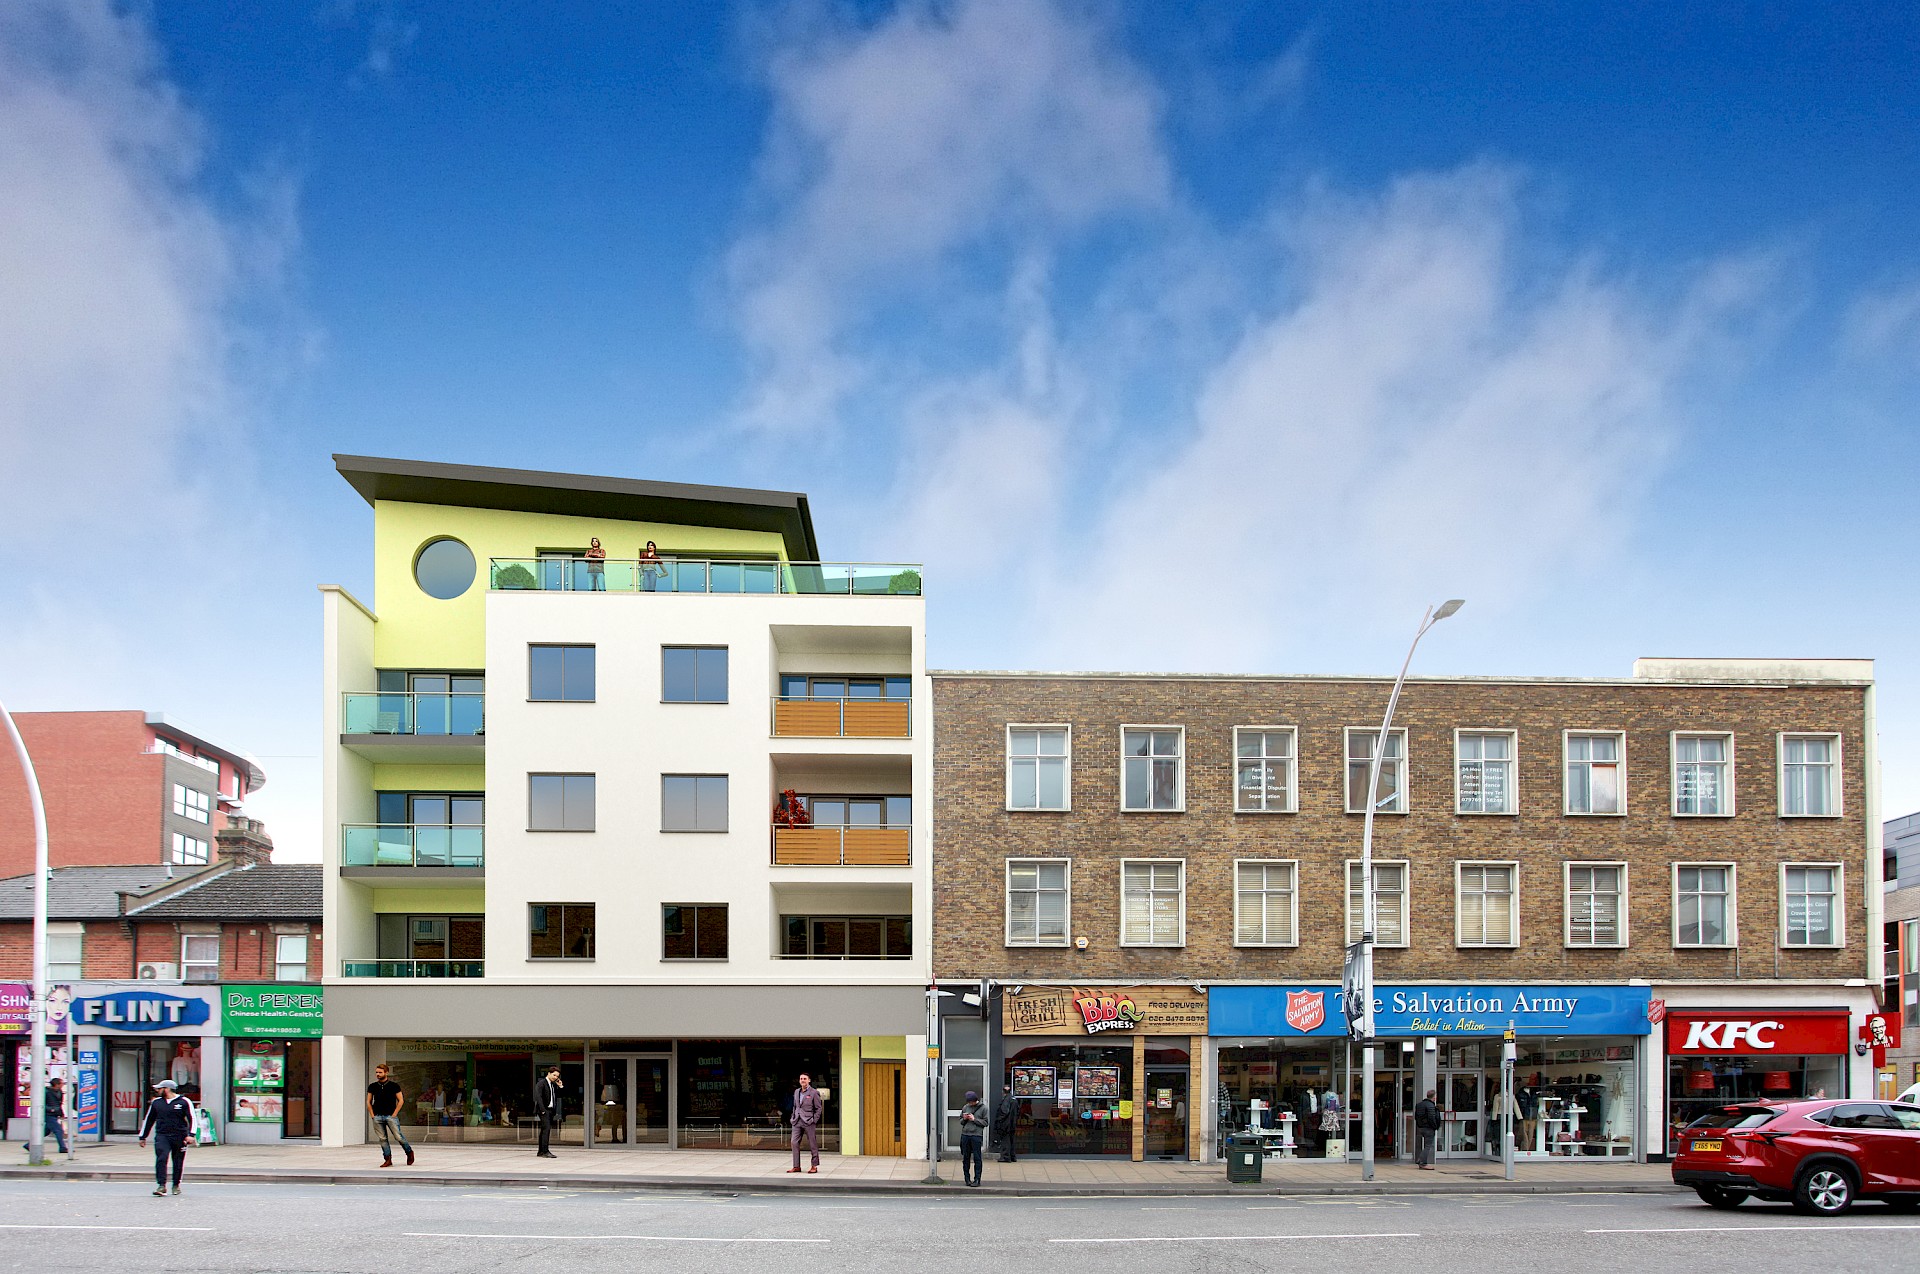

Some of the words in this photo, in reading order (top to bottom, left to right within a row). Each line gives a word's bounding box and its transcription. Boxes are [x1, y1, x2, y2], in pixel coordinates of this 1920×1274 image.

[228, 993, 255, 1008] Dr.
[1017, 997, 1057, 1011] FRESH
[1293, 995, 1309, 1008] THE
[1335, 992, 1384, 1014] Te
[1392, 991, 1504, 1014] Salvation
[1511, 991, 1579, 1018] Army
[83, 1000, 186, 1022] FLINT
[229, 1010, 260, 1018] Chinese
[260, 1010, 288, 1018] Health
[1021, 1007, 1037, 1016] OFF
[1040, 1005, 1055, 1014] THE
[1076, 996, 1146, 1025] BBQ
[1288, 996, 1322, 1022] SALVATION
[1020, 1012, 1059, 1024] GRILL
[1300, 1008, 1320, 1028] ARMY
[1410, 1018, 1441, 1032] Belief
[1442, 1021, 1453, 1032] in
[1455, 1018, 1486, 1032] Action
[1086, 1020, 1135, 1035] EXPRESS
[1682, 1020, 1779, 1049] KFC
[114, 1091, 142, 1109] SALE
